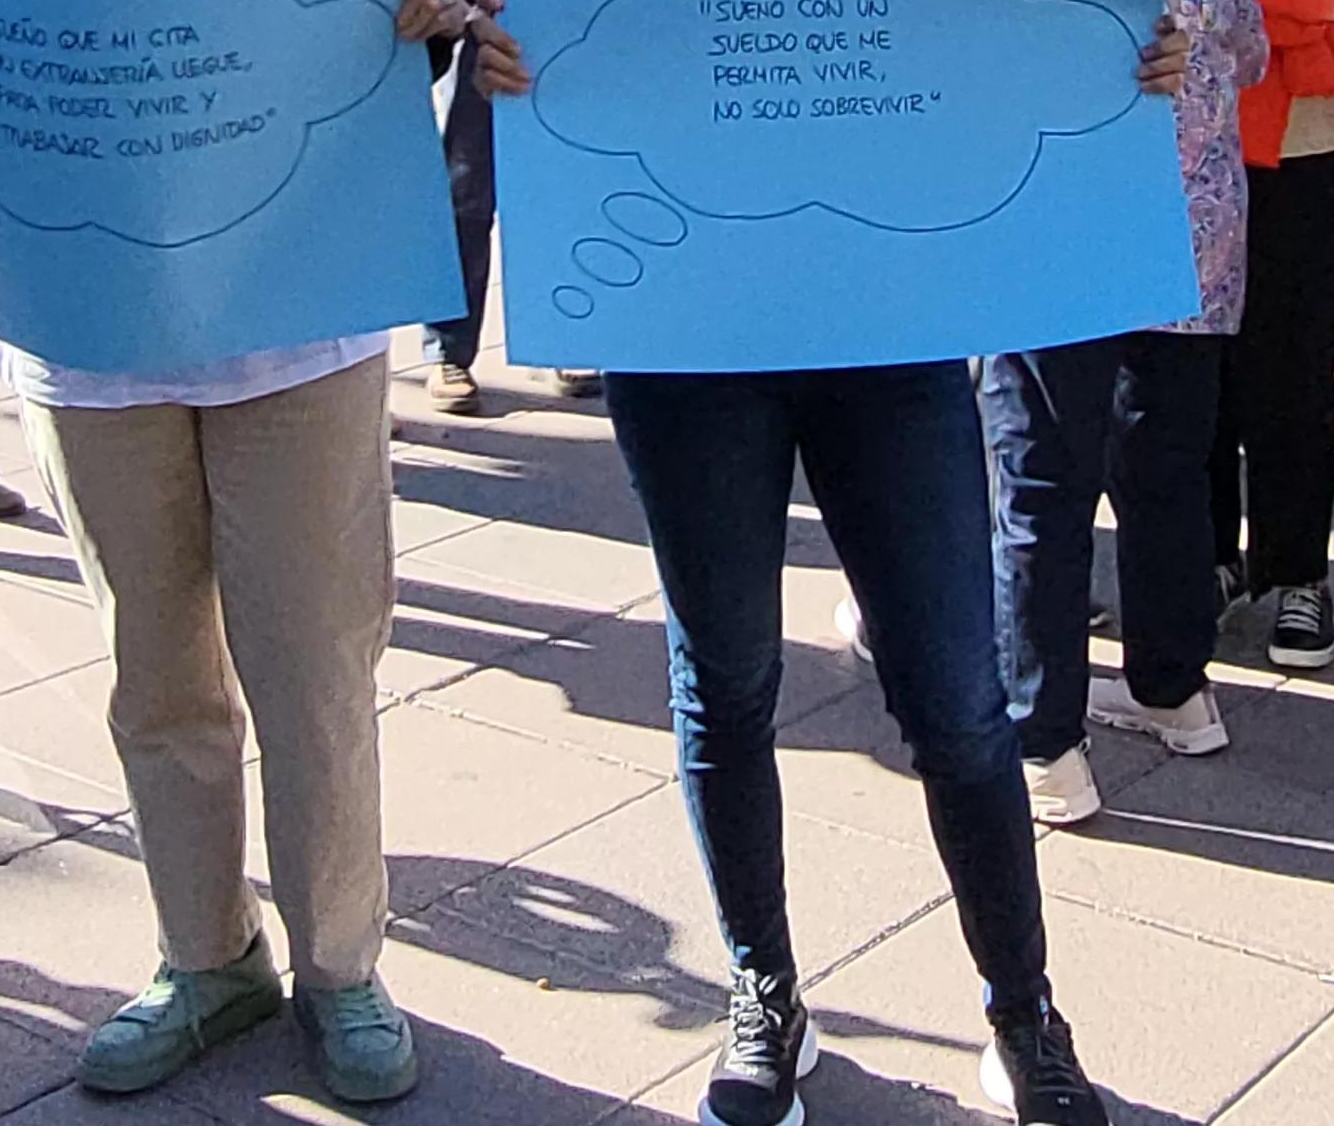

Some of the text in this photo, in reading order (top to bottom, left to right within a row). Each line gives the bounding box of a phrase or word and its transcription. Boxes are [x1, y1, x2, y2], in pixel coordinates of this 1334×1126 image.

[58, 29, 101, 52] QUE
[111, 30, 137, 51] MI
[148, 23, 201, 49] CITA
[707, 29, 892, 56] SUELDO QUE ME
[713, 59, 886, 87] PERMITA VIVIR,
[49, 96, 118, 119] PODER
[128, 95, 190, 119] VIVIR
[200, 91, 219, 113] Y
[713, 99, 742, 122] NO
[752, 98, 801, 119] SOLO
[116, 136, 163, 157] CON
